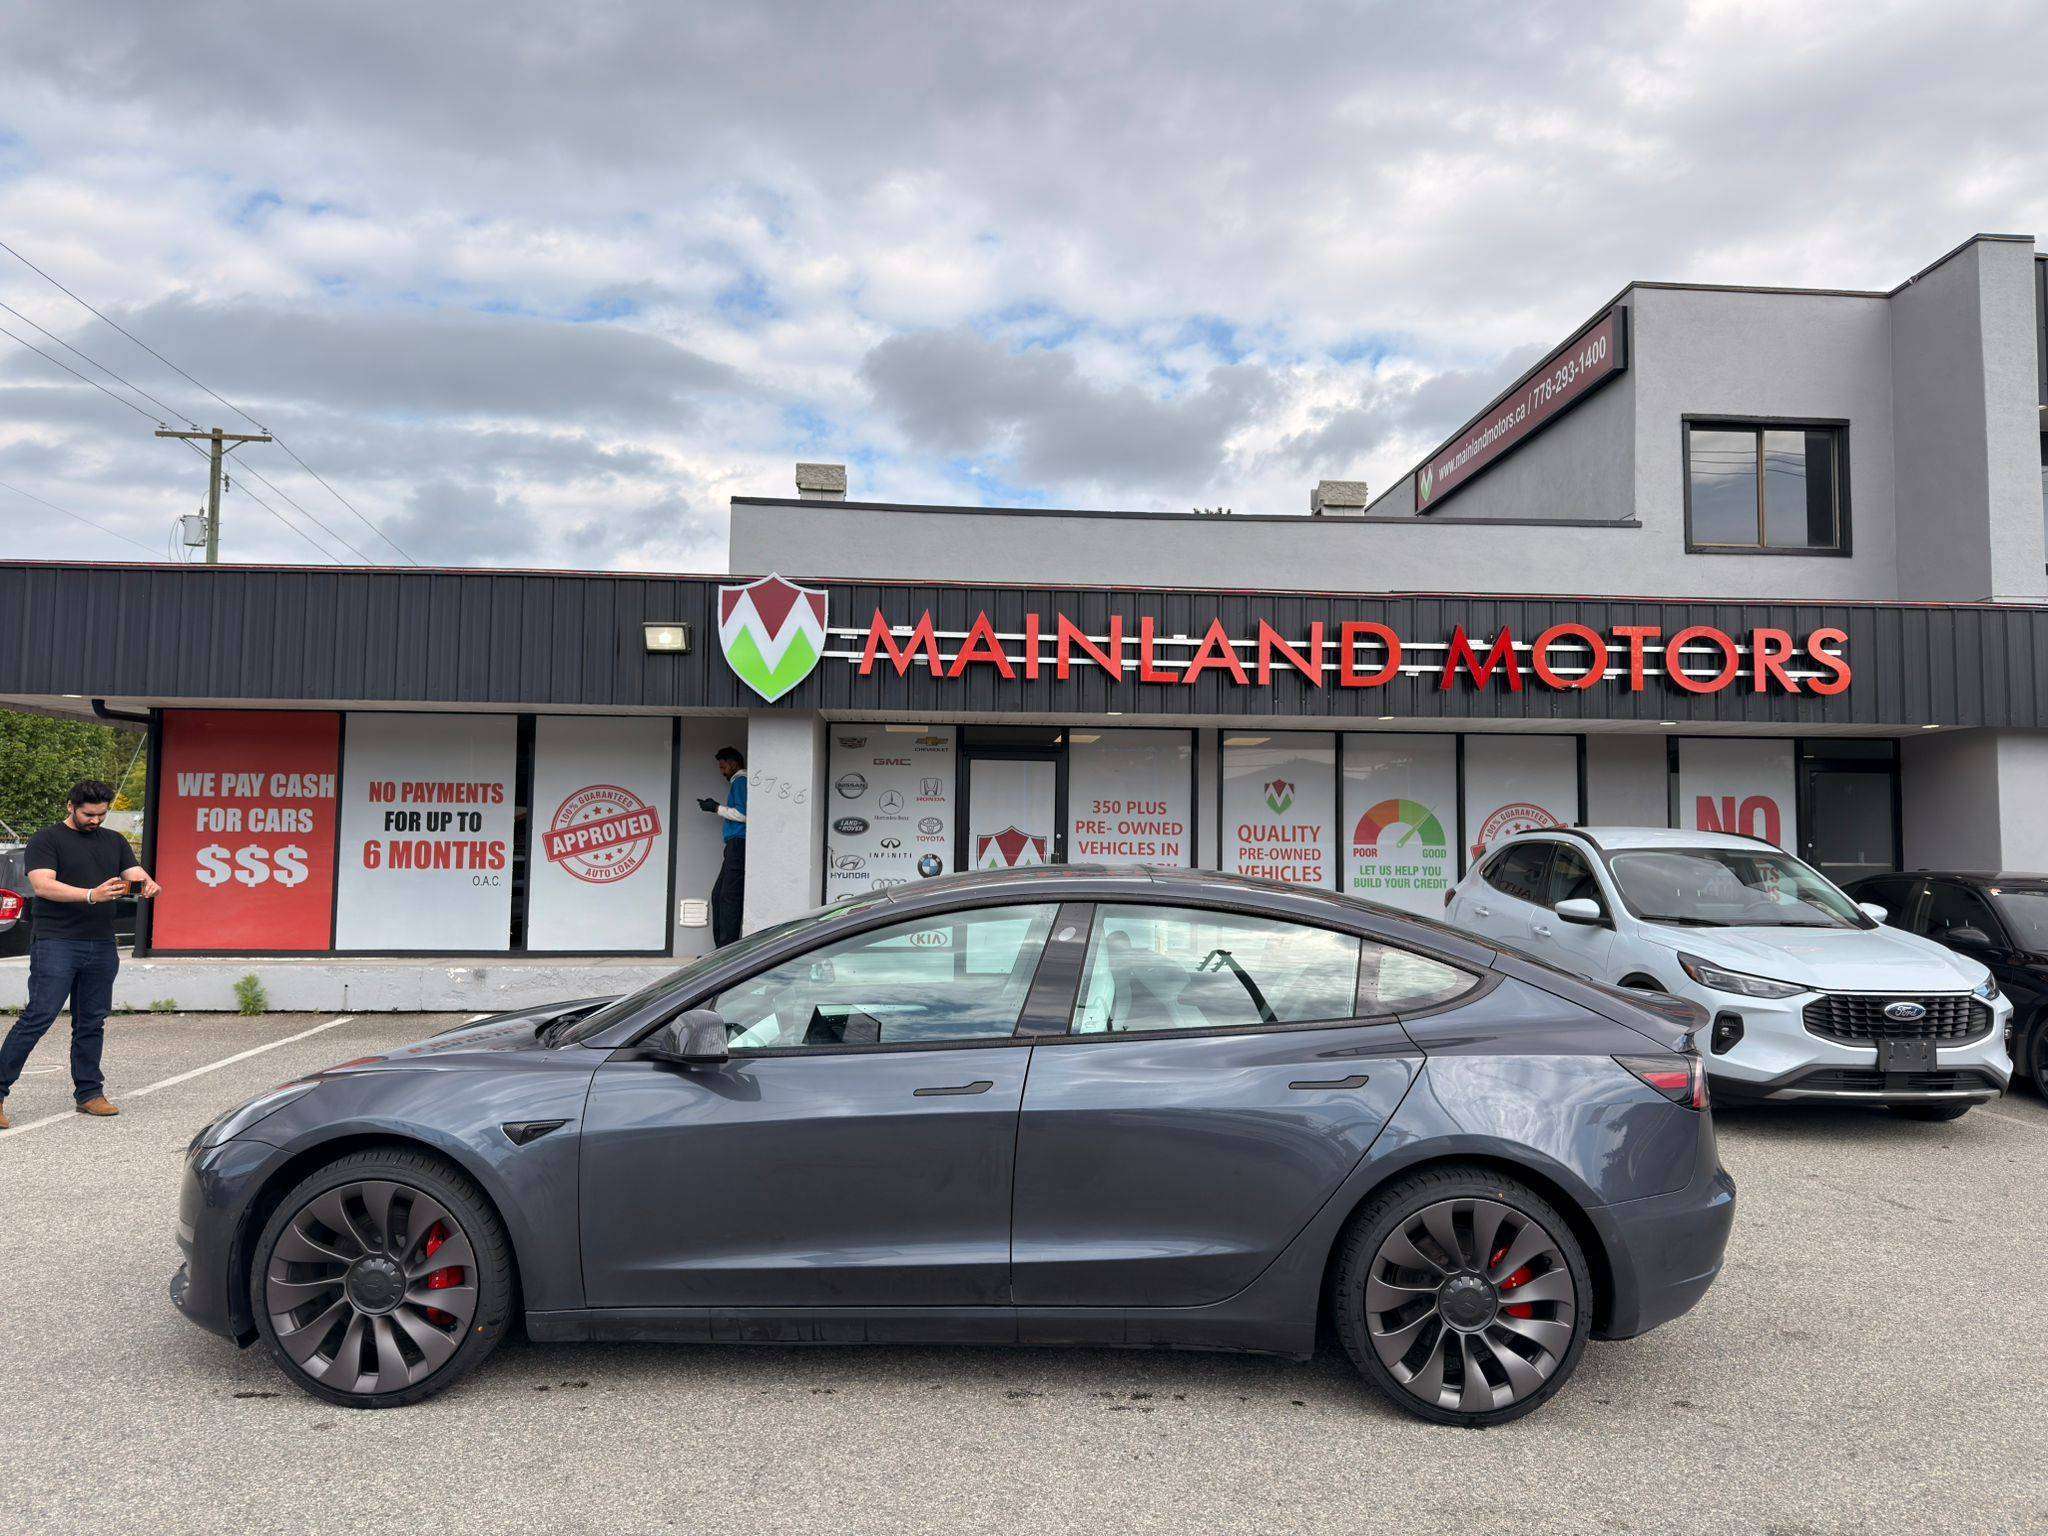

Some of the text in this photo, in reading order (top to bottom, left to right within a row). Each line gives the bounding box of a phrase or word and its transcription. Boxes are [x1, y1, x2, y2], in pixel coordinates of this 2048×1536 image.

[1438, 403, 1526, 482] www.mainlandmotors.ca
[1533, 335, 1607, 410] 778-293-1400
[858, 606, 1852, 696] MAINLAND MOTORS
[873, 758, 912, 766] GMC
[177, 772, 335, 798] WE PAY CASH
[368, 781, 504, 804] NO PAYMENTS
[560, 790, 634, 825] 100% GUARANTEED
[1092, 800, 1168, 815] 350 PLUS
[195, 807, 314, 833] FOR CARS
[384, 811, 483, 833] FOR UP TO
[1500, 808, 1549, 826] GUARANTEED
[1696, 796, 1781, 848] NO
[552, 814, 654, 856] APPROVED
[1075, 821, 1184, 836] PRE- OWNED
[1237, 824, 1322, 844] QUALITY
[362, 840, 506, 870] 6 MONTHS
[1079, 841, 1179, 856] VEHICLES IN
[1239, 848, 1322, 861] PRE-OWNED
[1353, 848, 1378, 858] POOR
[1422, 849, 1447, 858] GOOD
[195, 844, 309, 888] $$$
[585, 857, 637, 878] AUTO LOAN
[1238, 865, 1323, 882] VEHICLES
[1360, 865, 1442, 876] LET US HELP YOU
[472, 876, 502, 886] O.A.C.
[1353, 878, 1449, 889] BUILD YOUR CREDIT
[916, 933, 942, 945] KIA
[1894, 1005, 1919, 1016] Ford
